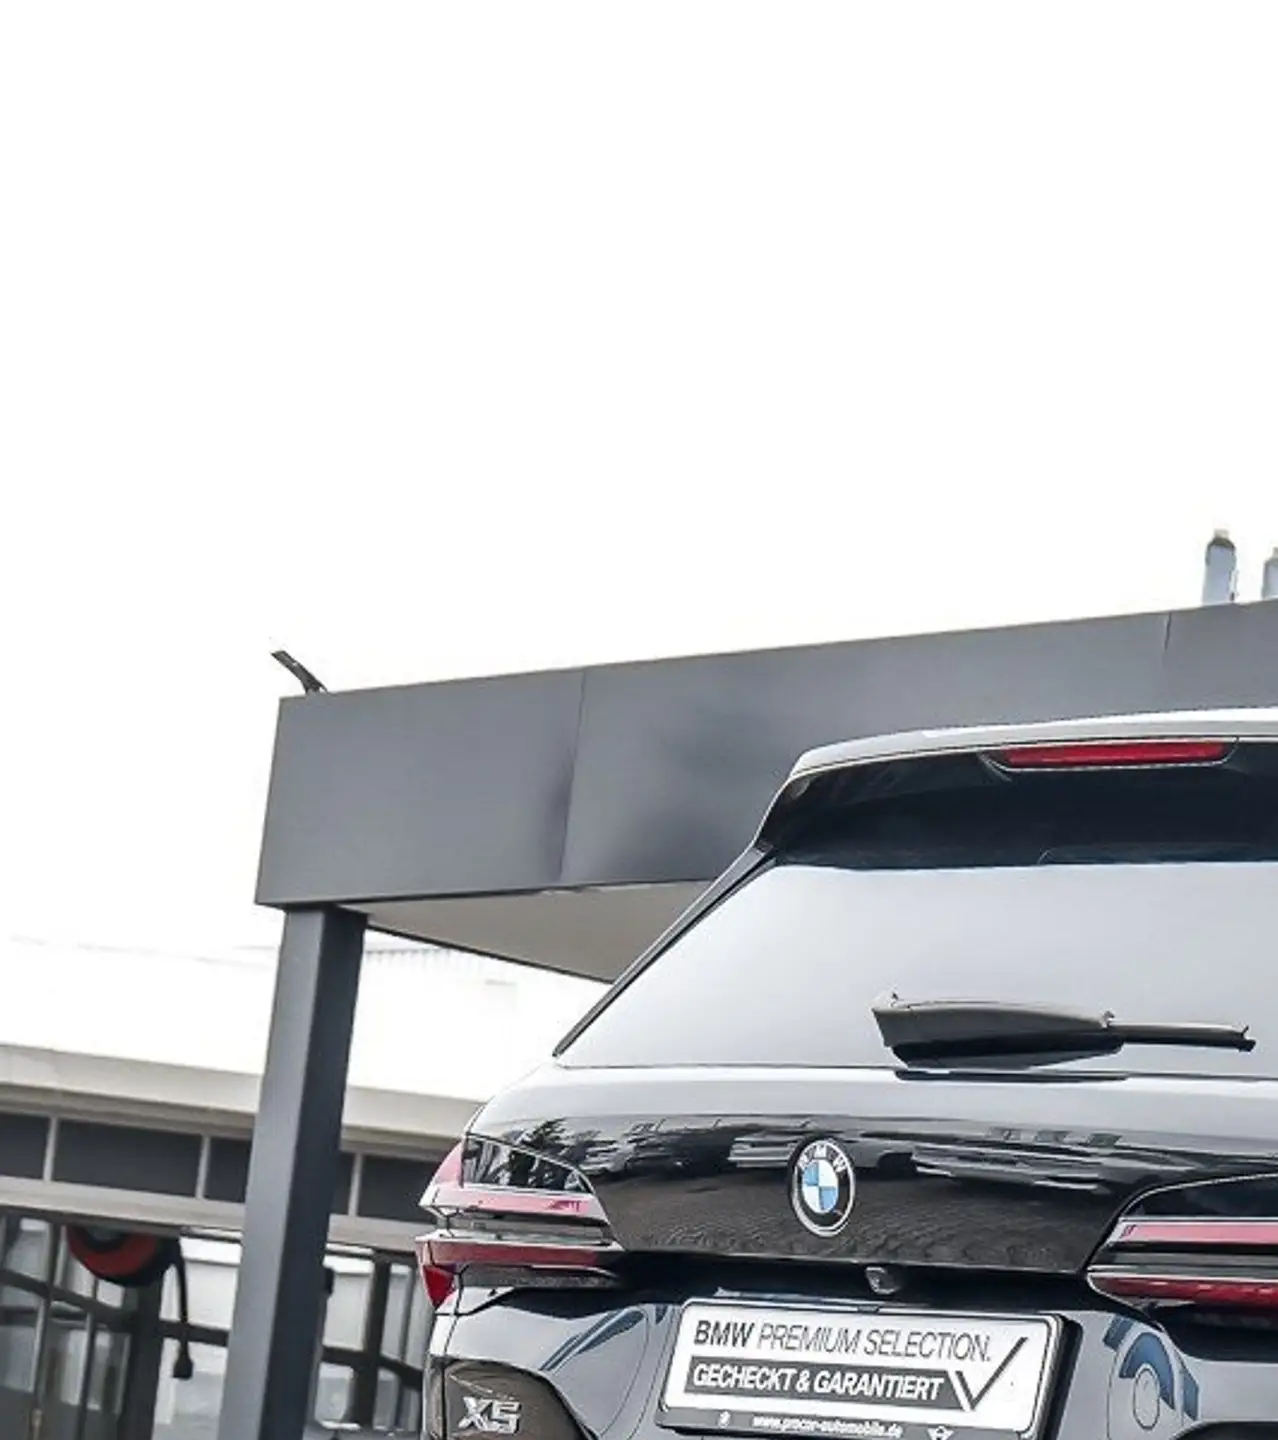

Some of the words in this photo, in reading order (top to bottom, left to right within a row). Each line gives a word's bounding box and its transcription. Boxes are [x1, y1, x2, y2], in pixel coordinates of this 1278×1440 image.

[797, 1144, 848, 1173] BMW
[693, 1319, 756, 1348] BMW
[757, 1322, 862, 1354] PREMIUM
[692, 1362, 799, 1392] GECHECKT
[794, 1368, 811, 1393] &
[813, 1369, 945, 1401] GARANTIERT
[457, 1396, 522, 1434] X5
